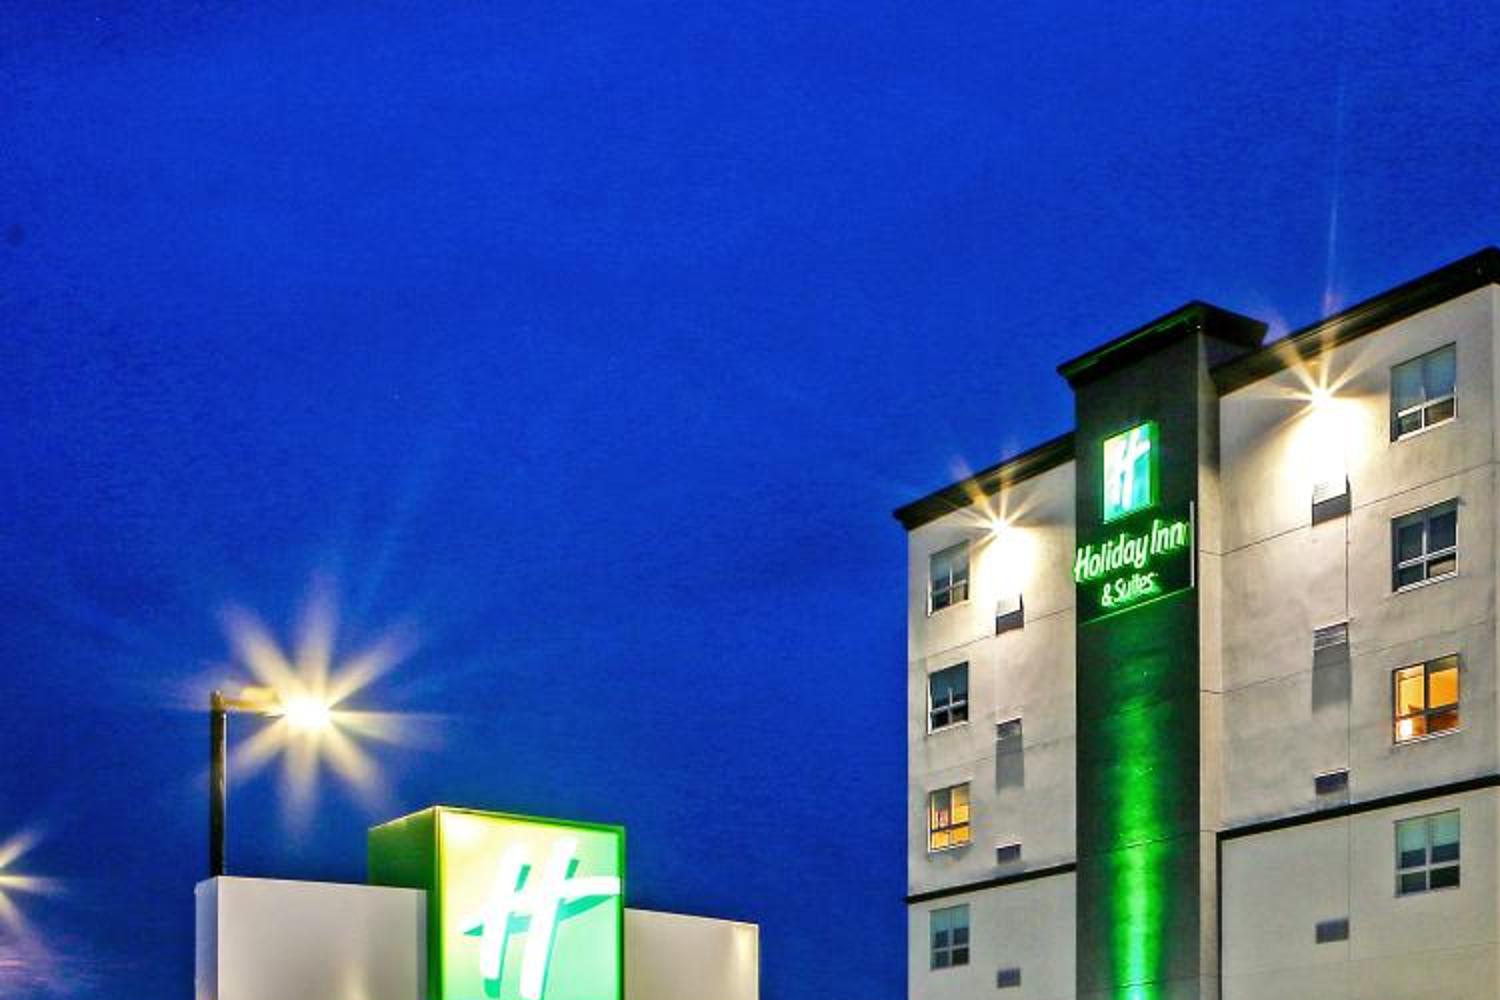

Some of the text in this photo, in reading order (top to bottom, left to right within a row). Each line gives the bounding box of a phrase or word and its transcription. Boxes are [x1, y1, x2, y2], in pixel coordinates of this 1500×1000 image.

[1075, 519, 1188, 583] Holiday Inn
[1101, 572, 1154, 607] & Suites
